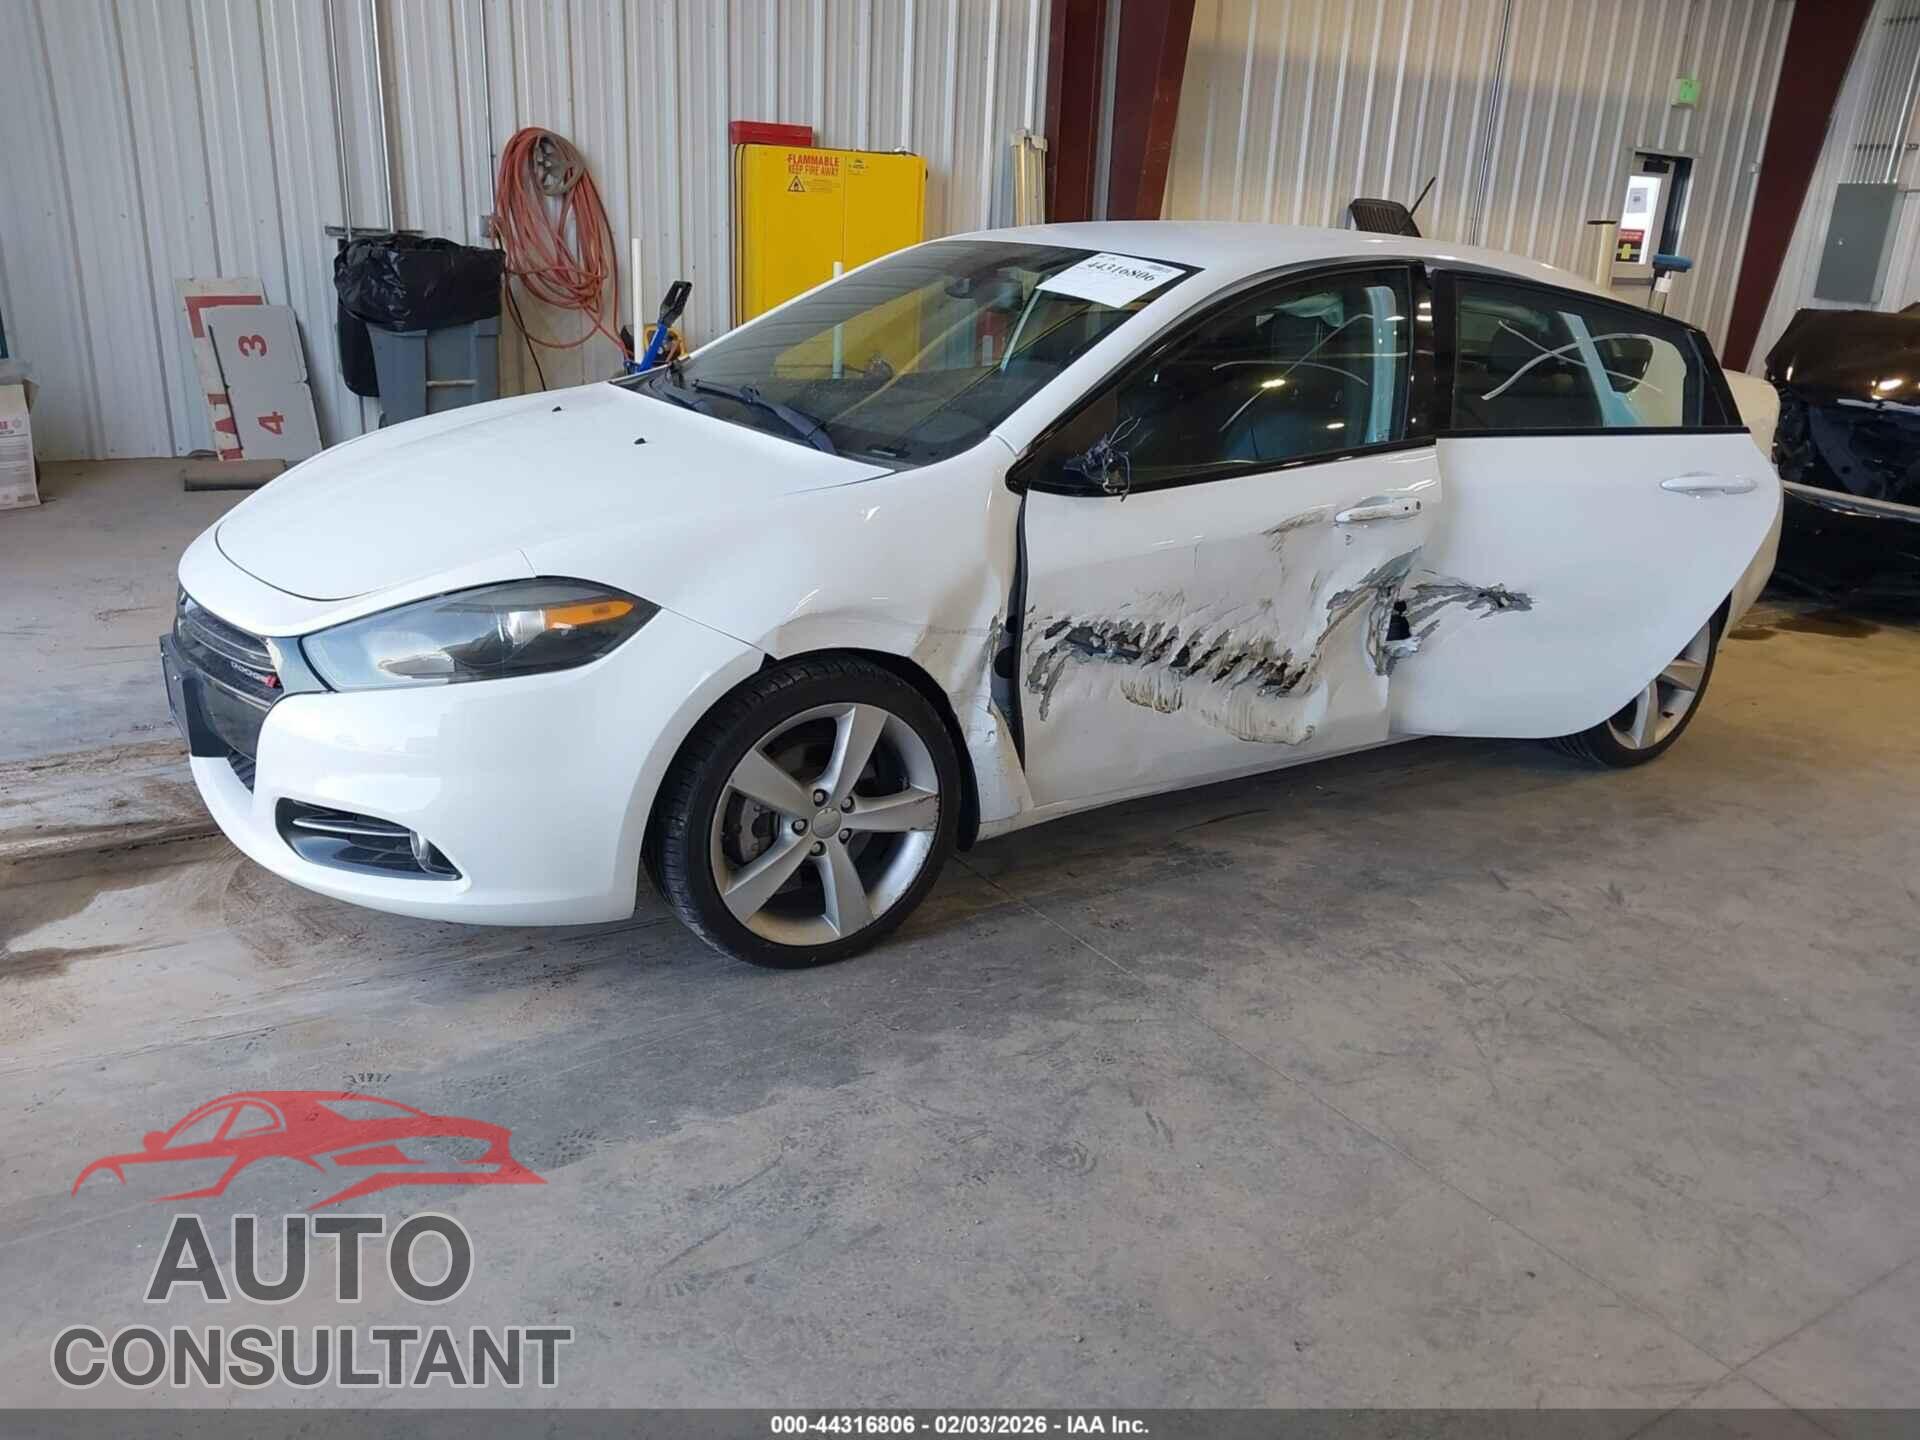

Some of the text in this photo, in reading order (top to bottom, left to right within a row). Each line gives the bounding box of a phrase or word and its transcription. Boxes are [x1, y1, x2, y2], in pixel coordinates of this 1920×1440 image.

[787, 153, 840, 166] FLAMMABLE
[788, 164, 803, 175] KEEP
[805, 165, 819, 176] FIRE
[820, 166, 839, 177] AWAY
[1087, 261, 1155, 281] 44316806
[238, 334, 268, 357] 3
[257, 411, 285, 435] 4
